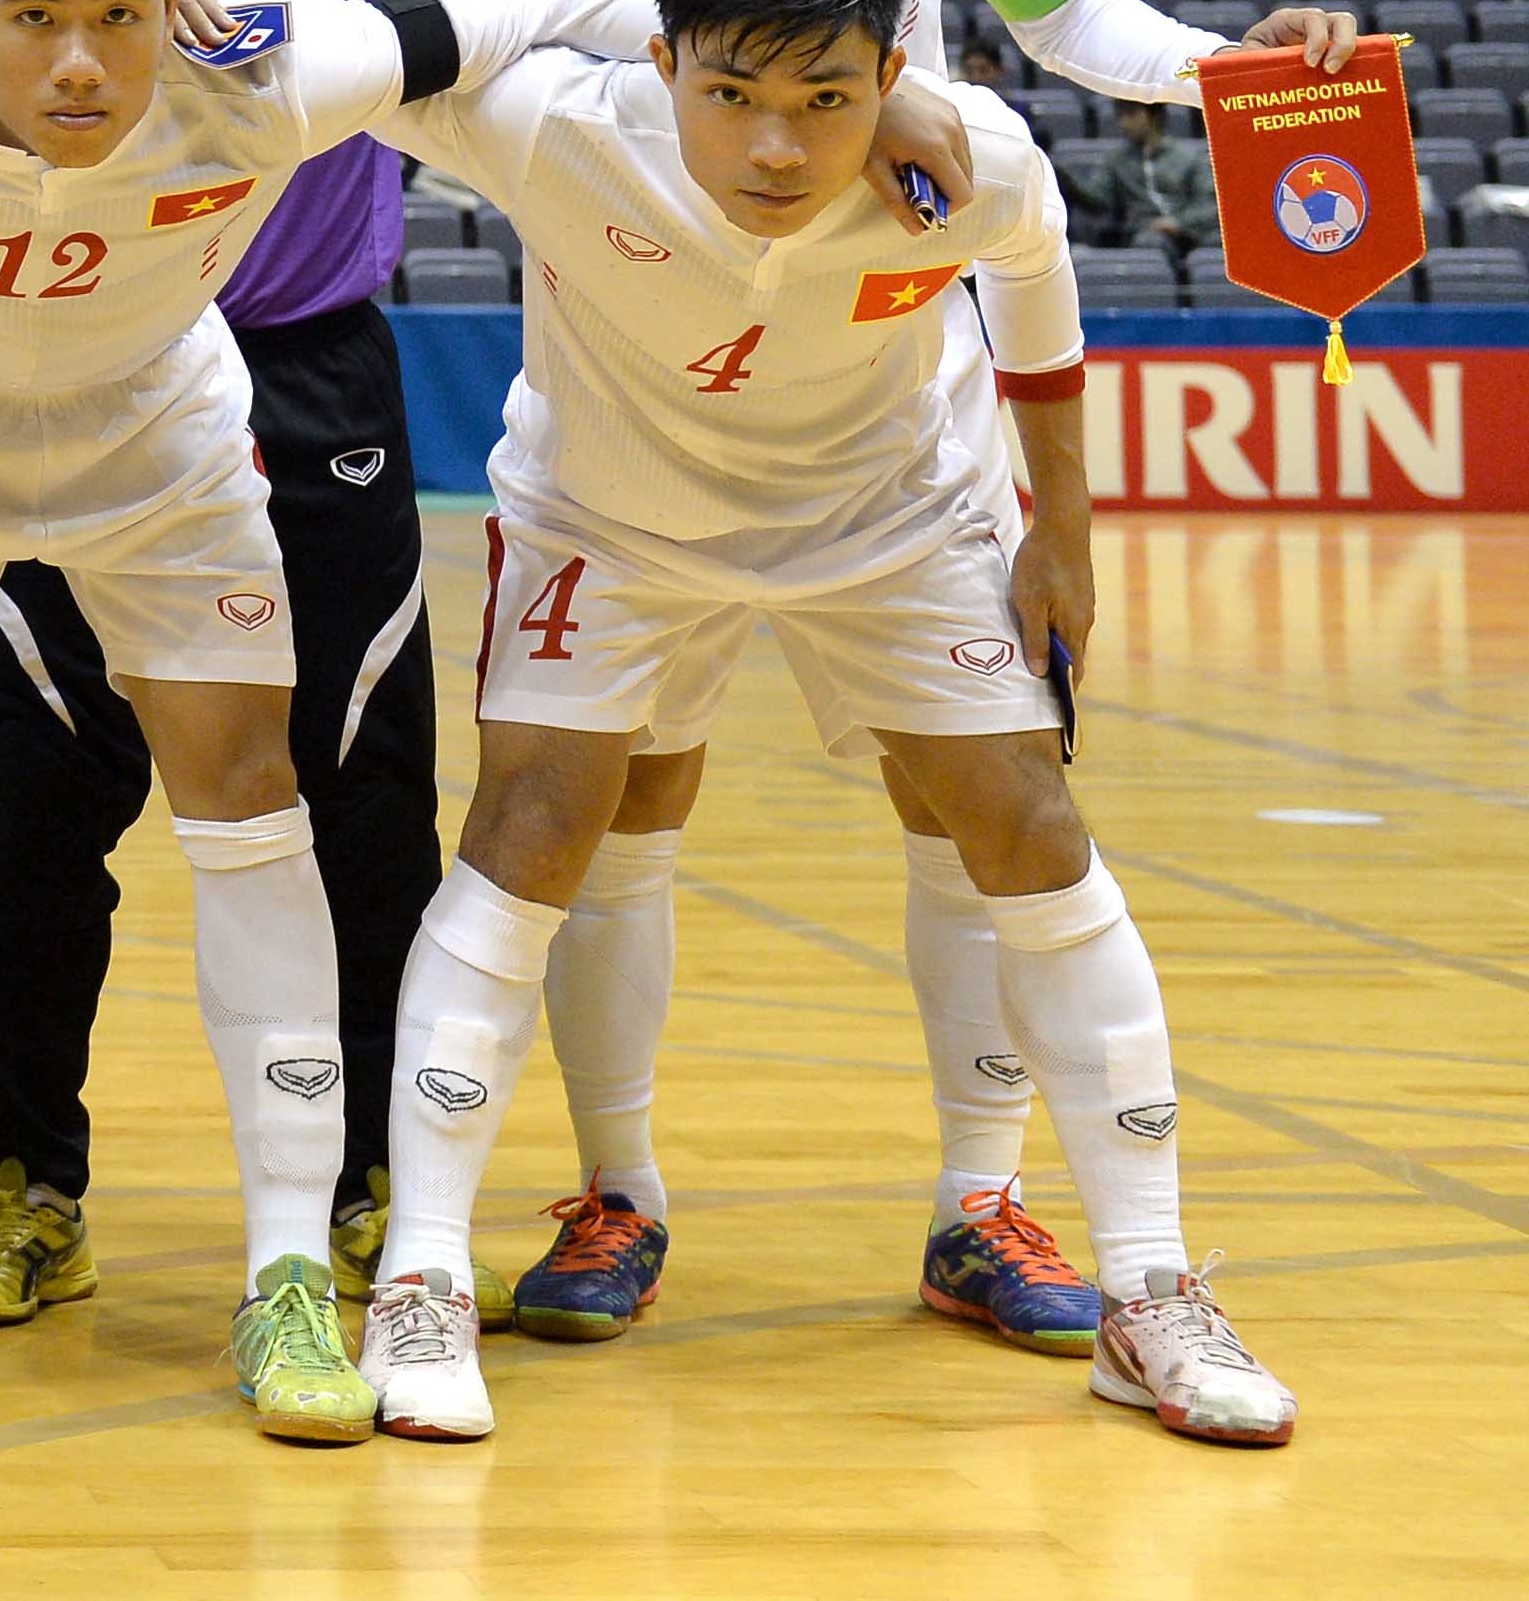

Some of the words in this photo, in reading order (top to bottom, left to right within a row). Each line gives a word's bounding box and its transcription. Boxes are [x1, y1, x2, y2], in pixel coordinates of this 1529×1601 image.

[1252, 104, 1362, 133] FEDERATION
[1312, 229, 1340, 245] VFF
[686, 324, 766, 393] 4
[1001, 362, 1465, 499] IRIN
[519, 557, 586, 660] 4
